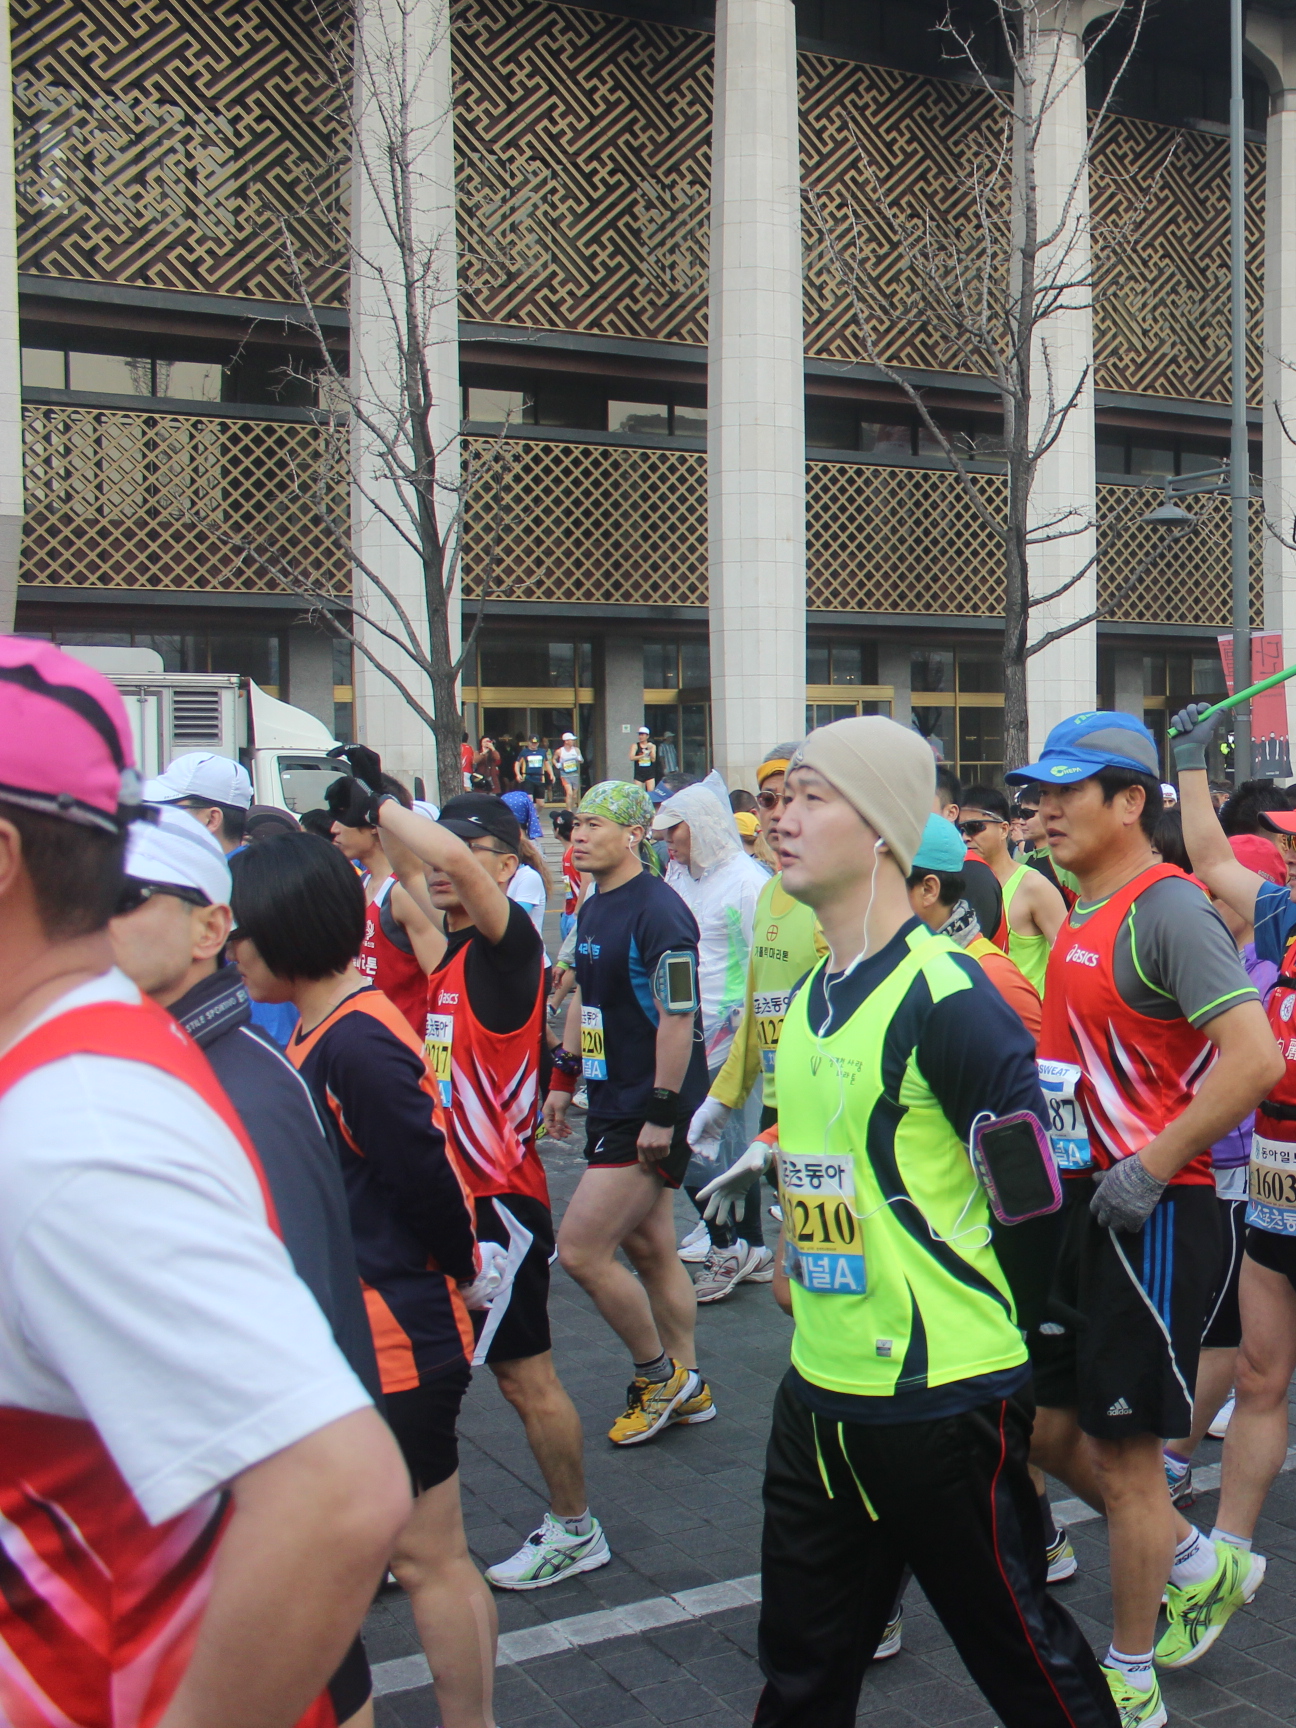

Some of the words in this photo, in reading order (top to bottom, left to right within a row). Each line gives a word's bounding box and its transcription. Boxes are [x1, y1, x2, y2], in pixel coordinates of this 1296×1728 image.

[1073, 951, 1099, 968] asics
[1038, 1062, 1070, 1077] SWEAT
[1051, 1098, 1078, 1132] 87
[1106, 1408, 1132, 1417] adidas
[1174, 1544, 1200, 1567] asics
